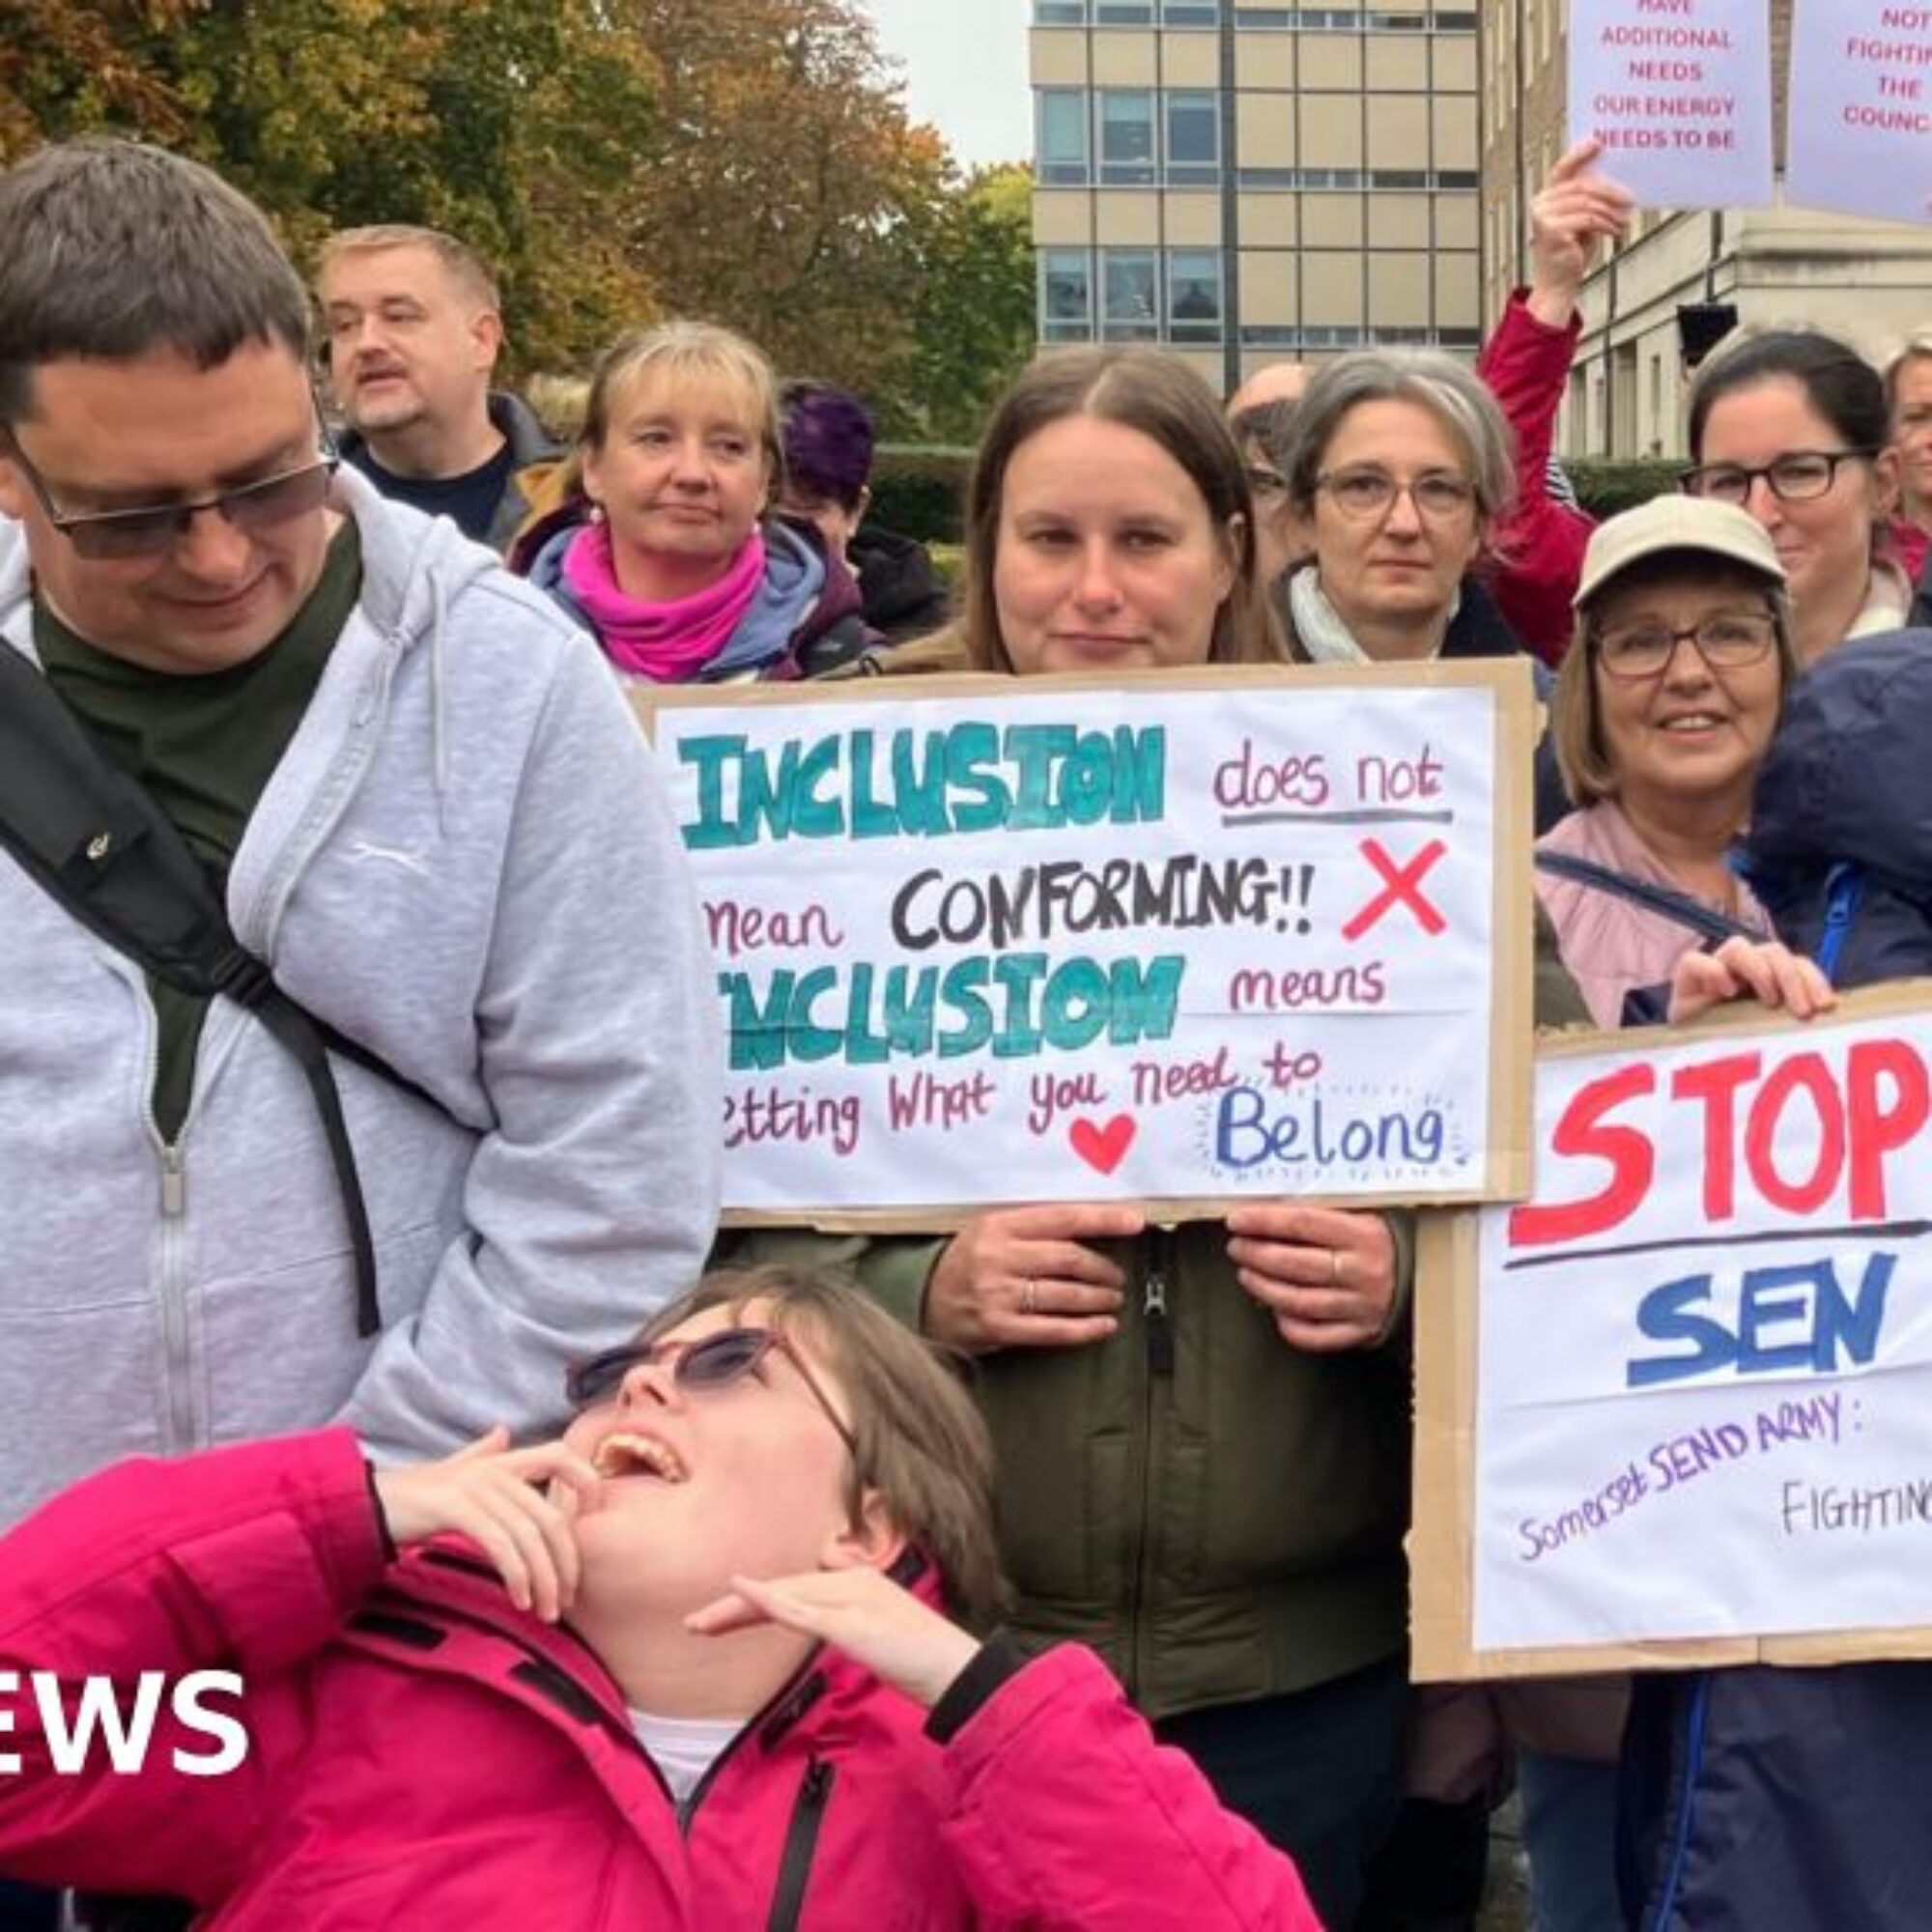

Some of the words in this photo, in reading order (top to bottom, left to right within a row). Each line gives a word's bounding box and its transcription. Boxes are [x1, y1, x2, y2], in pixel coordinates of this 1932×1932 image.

[1602, 25, 1734, 49] ADDITIONAL
[1882, 9, 1932, 29] NOT
[1594, 95, 1639, 115] OUR
[1646, 97, 1735, 117] ENERGY
[1630, 61, 1702, 81] NEEDS
[1879, 75, 1920, 99] THE
[1674, 130, 1702, 149] TO
[1707, 130, 1735, 150] BE
[678, 722, 1165, 850] INCLUSION
[1213, 737, 1329, 808] does
[1357, 744, 1443, 803] not
[891, 854, 1315, 951] CONFORMING!!
[718, 954, 1185, 1070] NCLUSION
[1230, 961, 1385, 1010] means
[1029, 1069, 1107, 1135] you
[1131, 1046, 1237, 1105] need
[1263, 1041, 1322, 1088] to
[1509, 1038, 1932, 1247] STOP
[1627, 1251, 1898, 1387] SEN
[1519, 1463, 1648, 1561] Somerset
[1649, 1423, 1749, 1492] SEND
